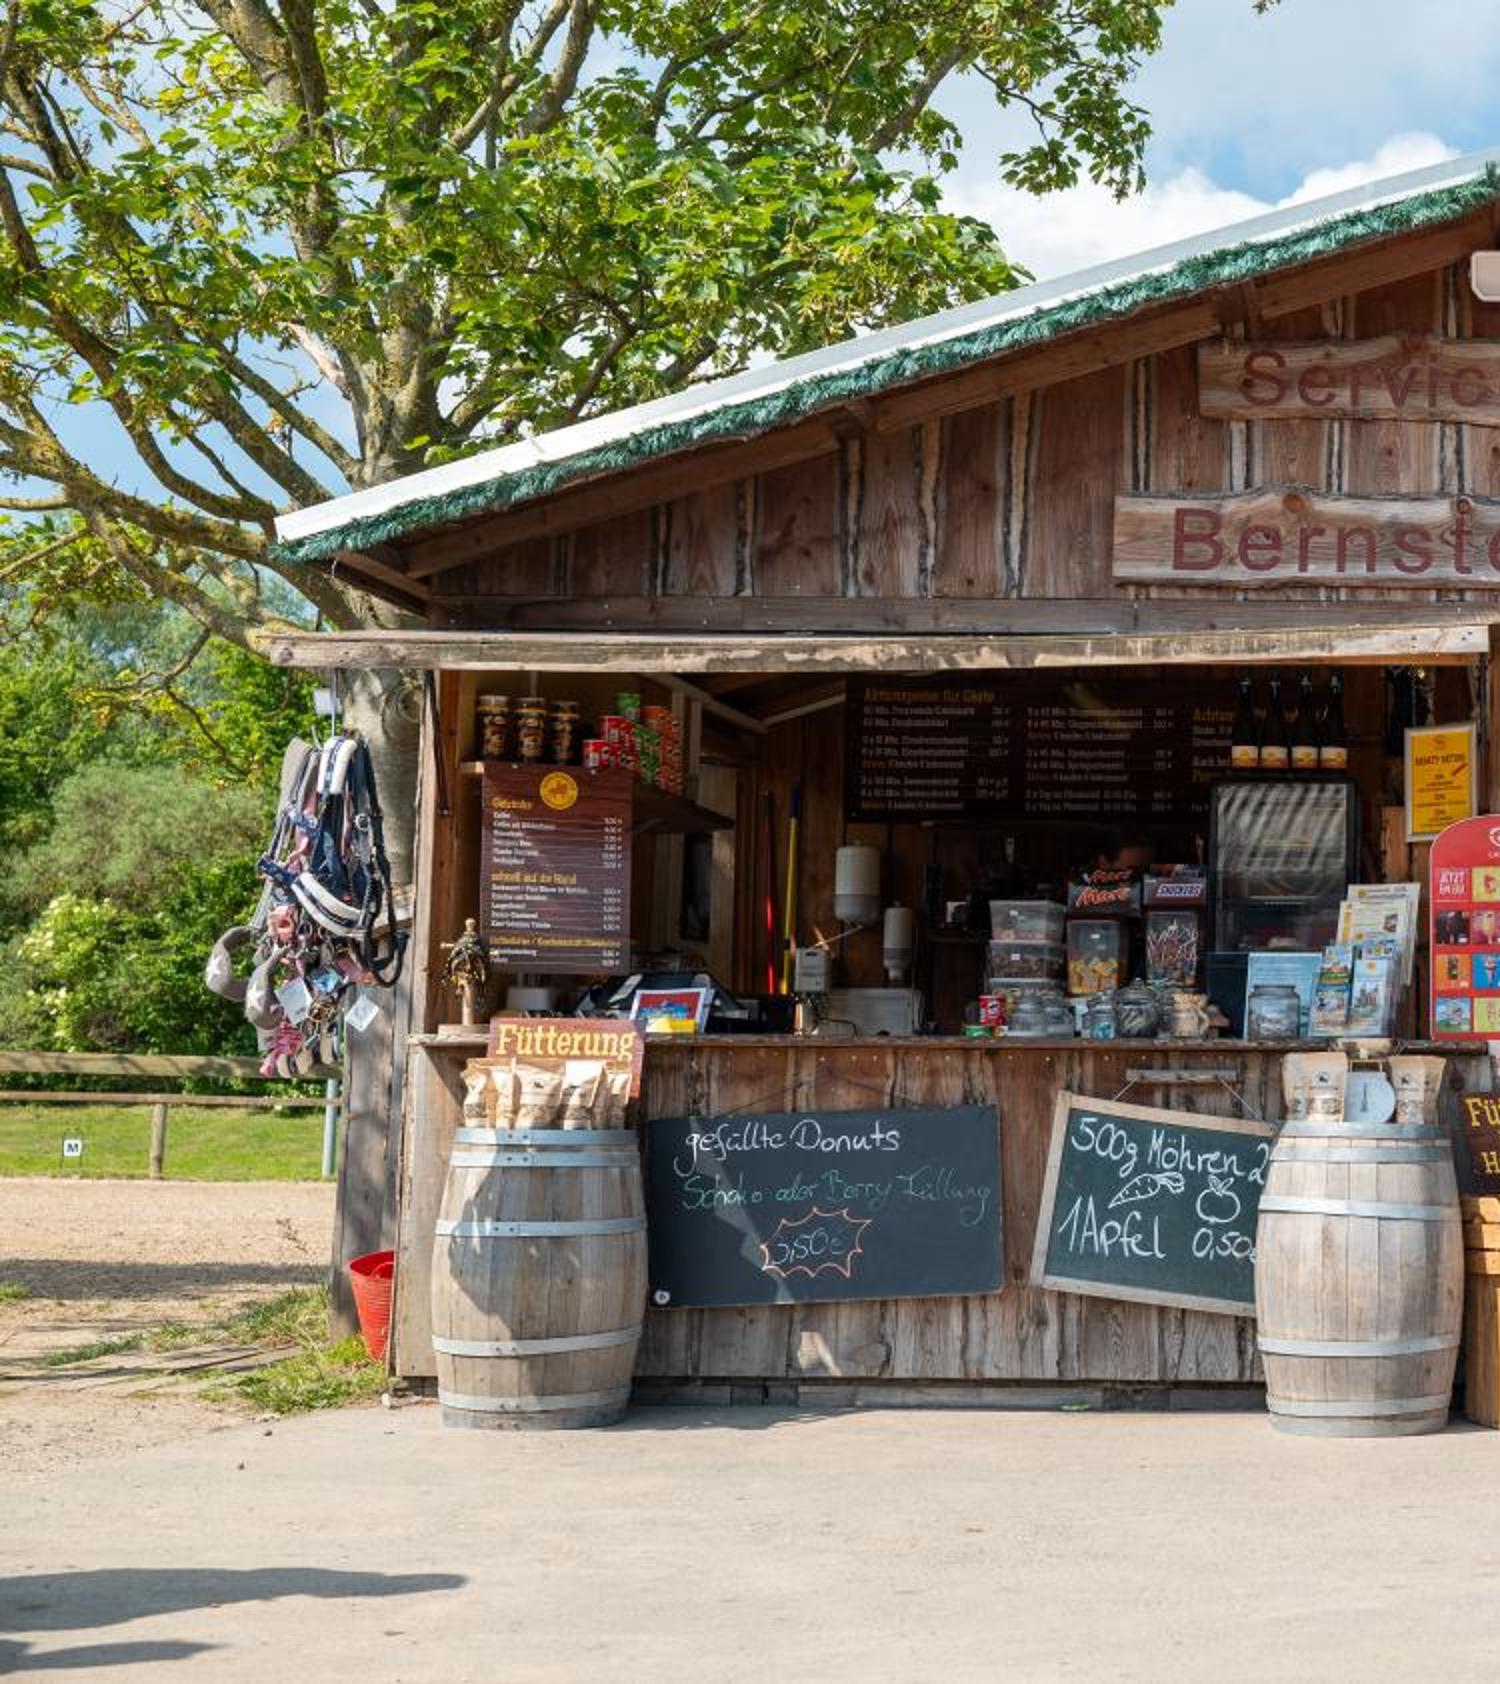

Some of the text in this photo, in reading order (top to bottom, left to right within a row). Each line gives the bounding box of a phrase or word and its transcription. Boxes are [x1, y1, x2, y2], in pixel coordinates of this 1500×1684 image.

[495, 1022, 637, 1062] Fütterung
[67, 1143, 79, 1153] M
[789, 1118, 901, 1153] Donuts
[1070, 1116, 1139, 1179] 500g
[1147, 1128, 1247, 1178] Möhren
[682, 1171, 763, 1210] Schoko
[775, 1171, 821, 1203] oder
[821, 1168, 893, 1213] Berry
